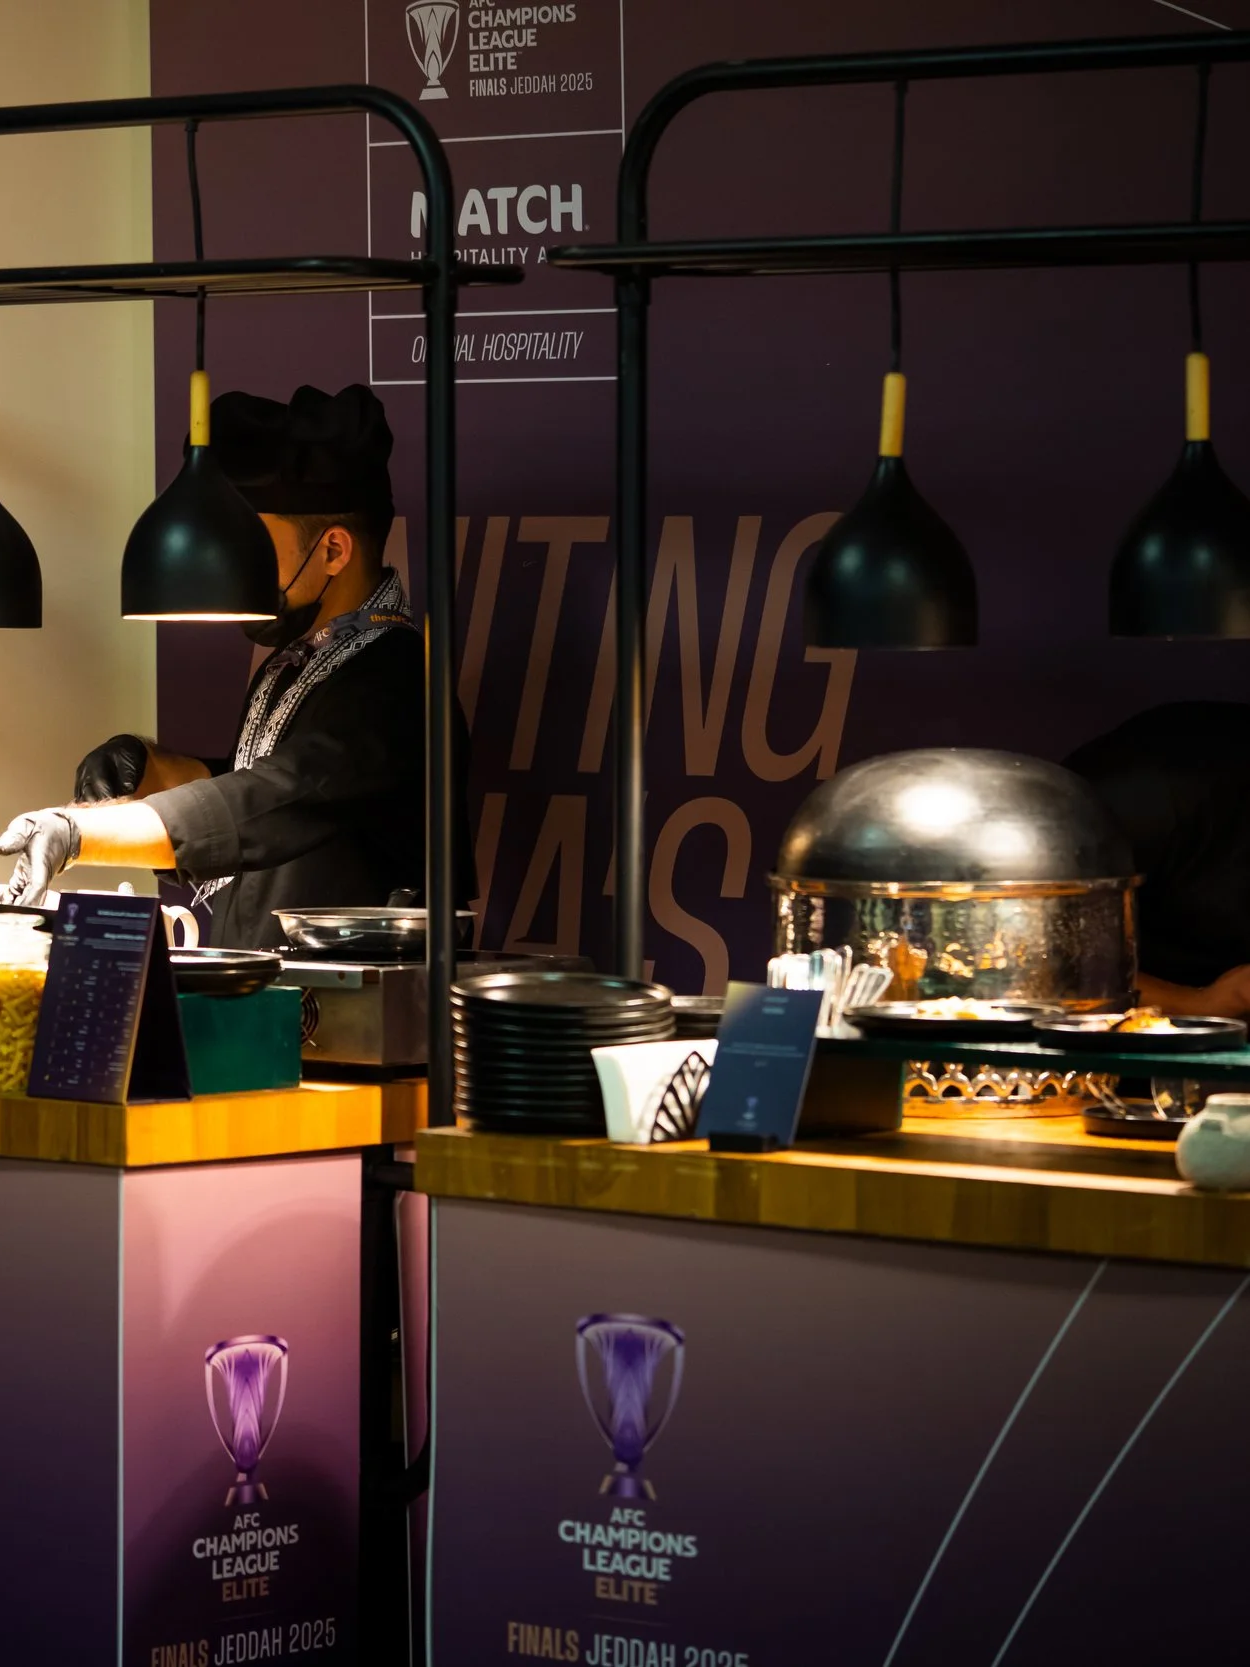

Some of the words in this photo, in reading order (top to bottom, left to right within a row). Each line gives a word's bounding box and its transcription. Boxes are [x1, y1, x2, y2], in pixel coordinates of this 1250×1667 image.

[467, 4, 577, 29] CHAMPIONS
[468, 28, 538, 51] LEAGUE
[469, 51, 518, 73] ELITE
[469, 77, 507, 97] FINALS
[510, 74, 556, 96] JEDDAH
[560, 72, 593, 92] 2025
[411, 247, 529, 266] HPITALITY
[481, 331, 584, 362] HOSPITALITY
[233, 1512, 261, 1530] AFC
[609, 1507, 647, 1527] AFC
[192, 1523, 300, 1559] CHAMPIONS
[558, 1519, 699, 1558] CHAMPIONS
[211, 1550, 281, 1581] LEAGUE
[582, 1547, 673, 1582] LEAGUE
[221, 1576, 270, 1603] ELITE
[594, 1575, 659, 1606] ELITE
[151, 1639, 209, 1667] FINALS
[214, 1626, 283, 1667] JEDDAH
[289, 1617, 337, 1654] 2025
[507, 1621, 580, 1663] FINALS
[585, 1633, 676, 1667] JEDDAH
